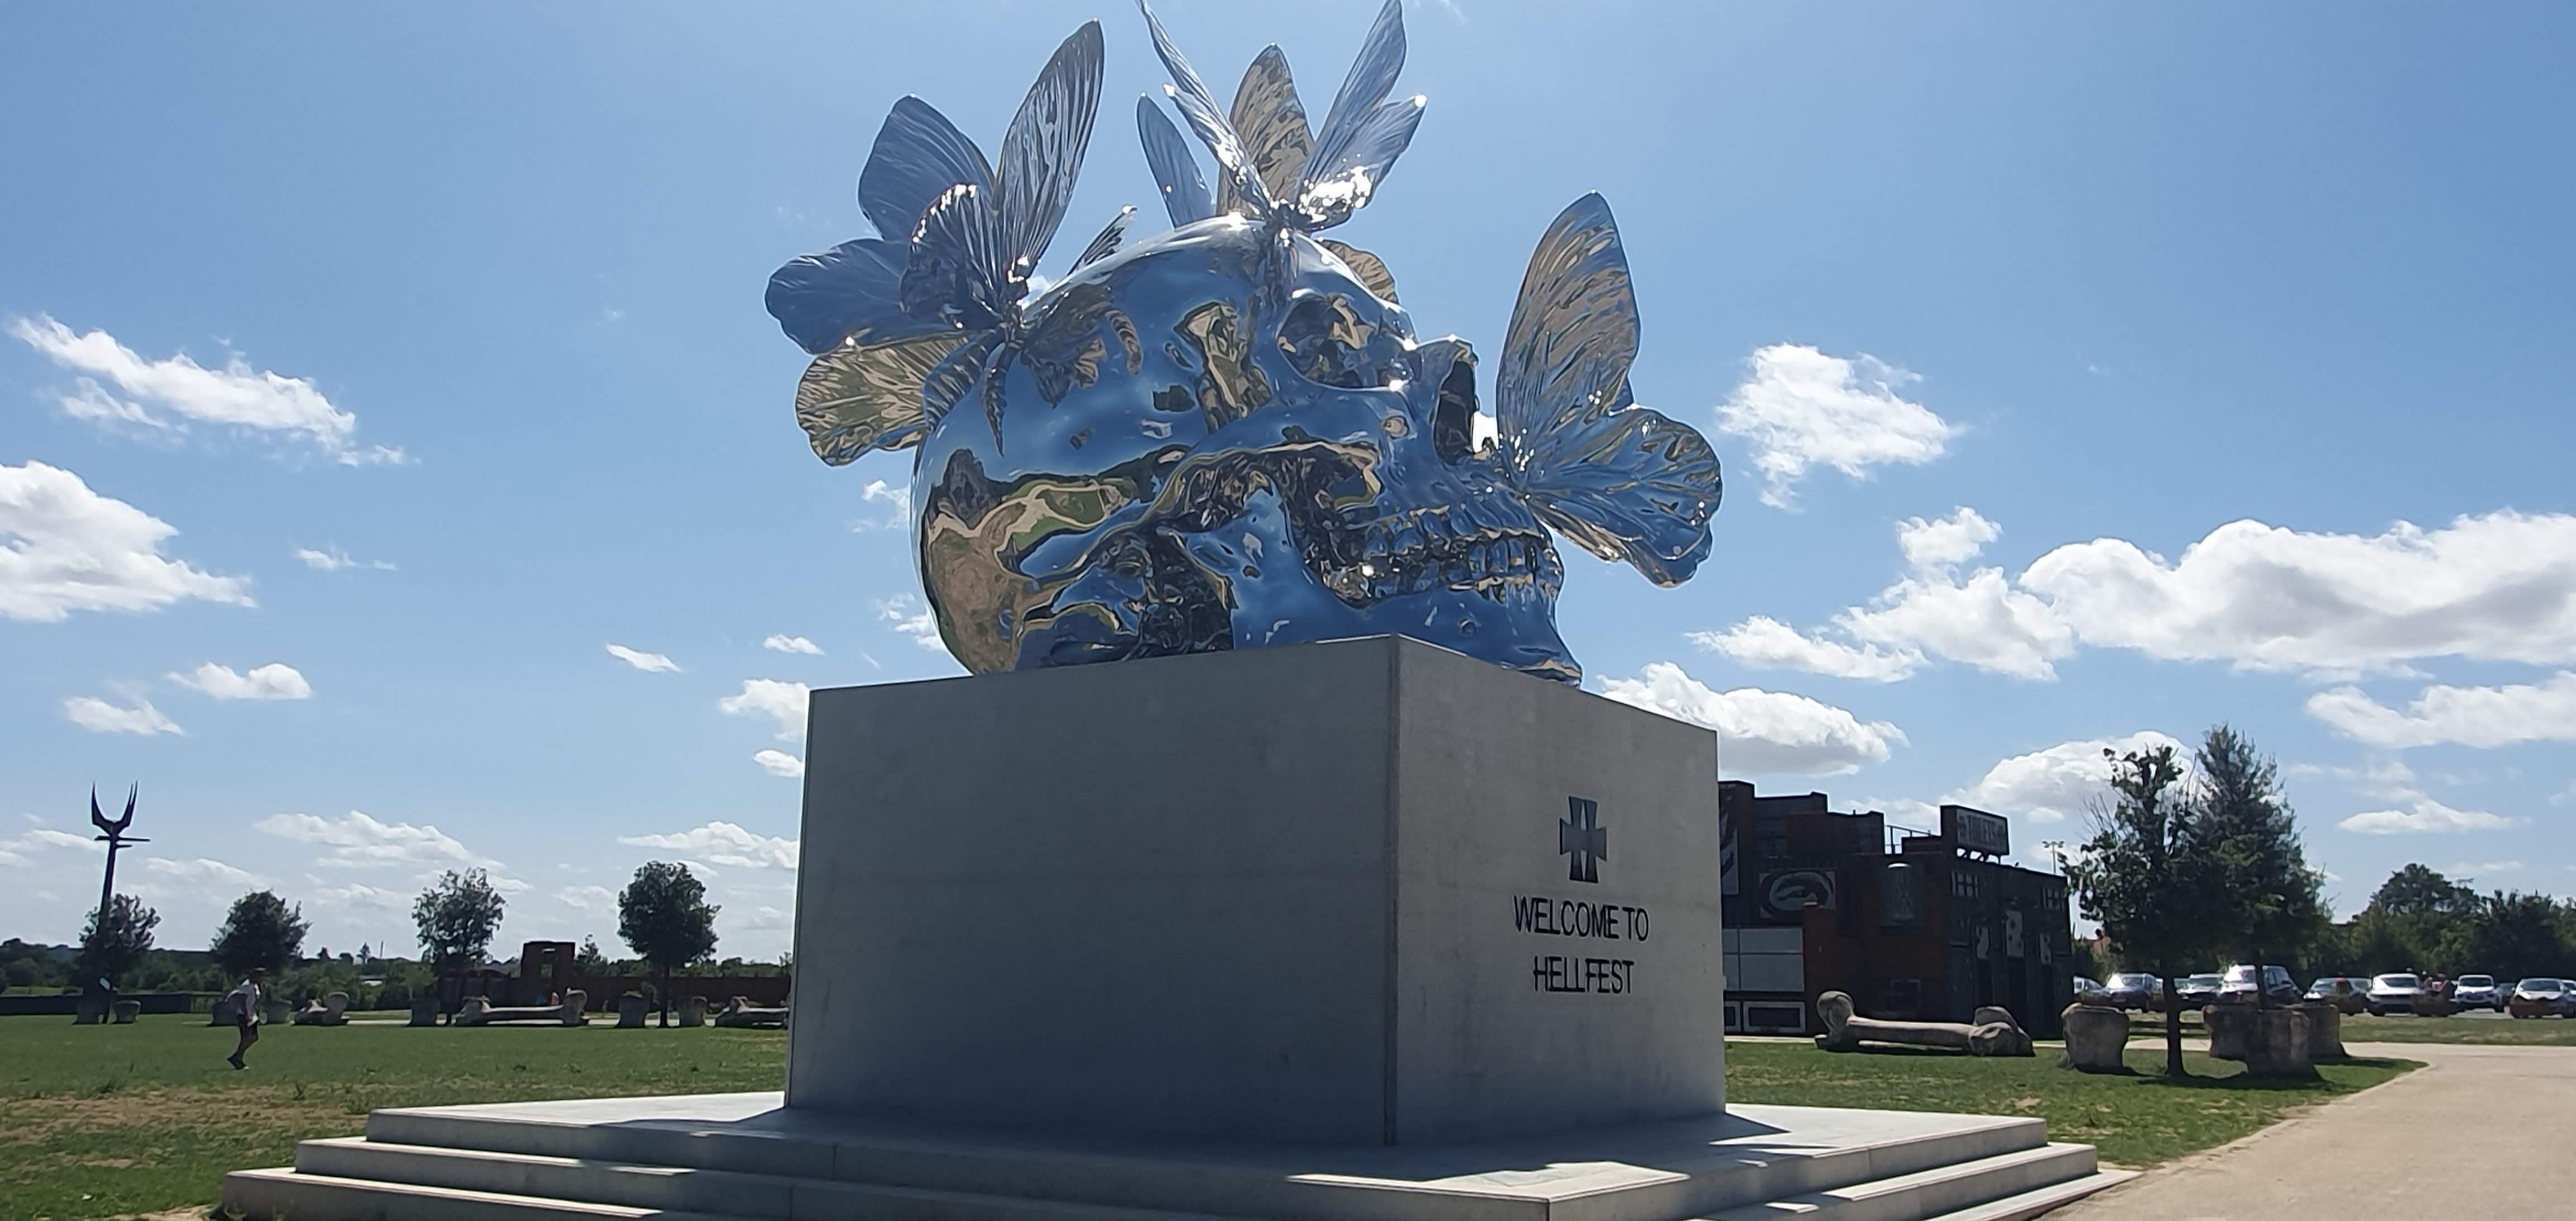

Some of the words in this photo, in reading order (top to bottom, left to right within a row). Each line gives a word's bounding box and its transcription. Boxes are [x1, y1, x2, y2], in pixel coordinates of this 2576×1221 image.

[1513, 895, 1620, 939] WELCOME
[1622, 906, 1649, 941] TO
[1533, 955, 1635, 994] HELLFEST
